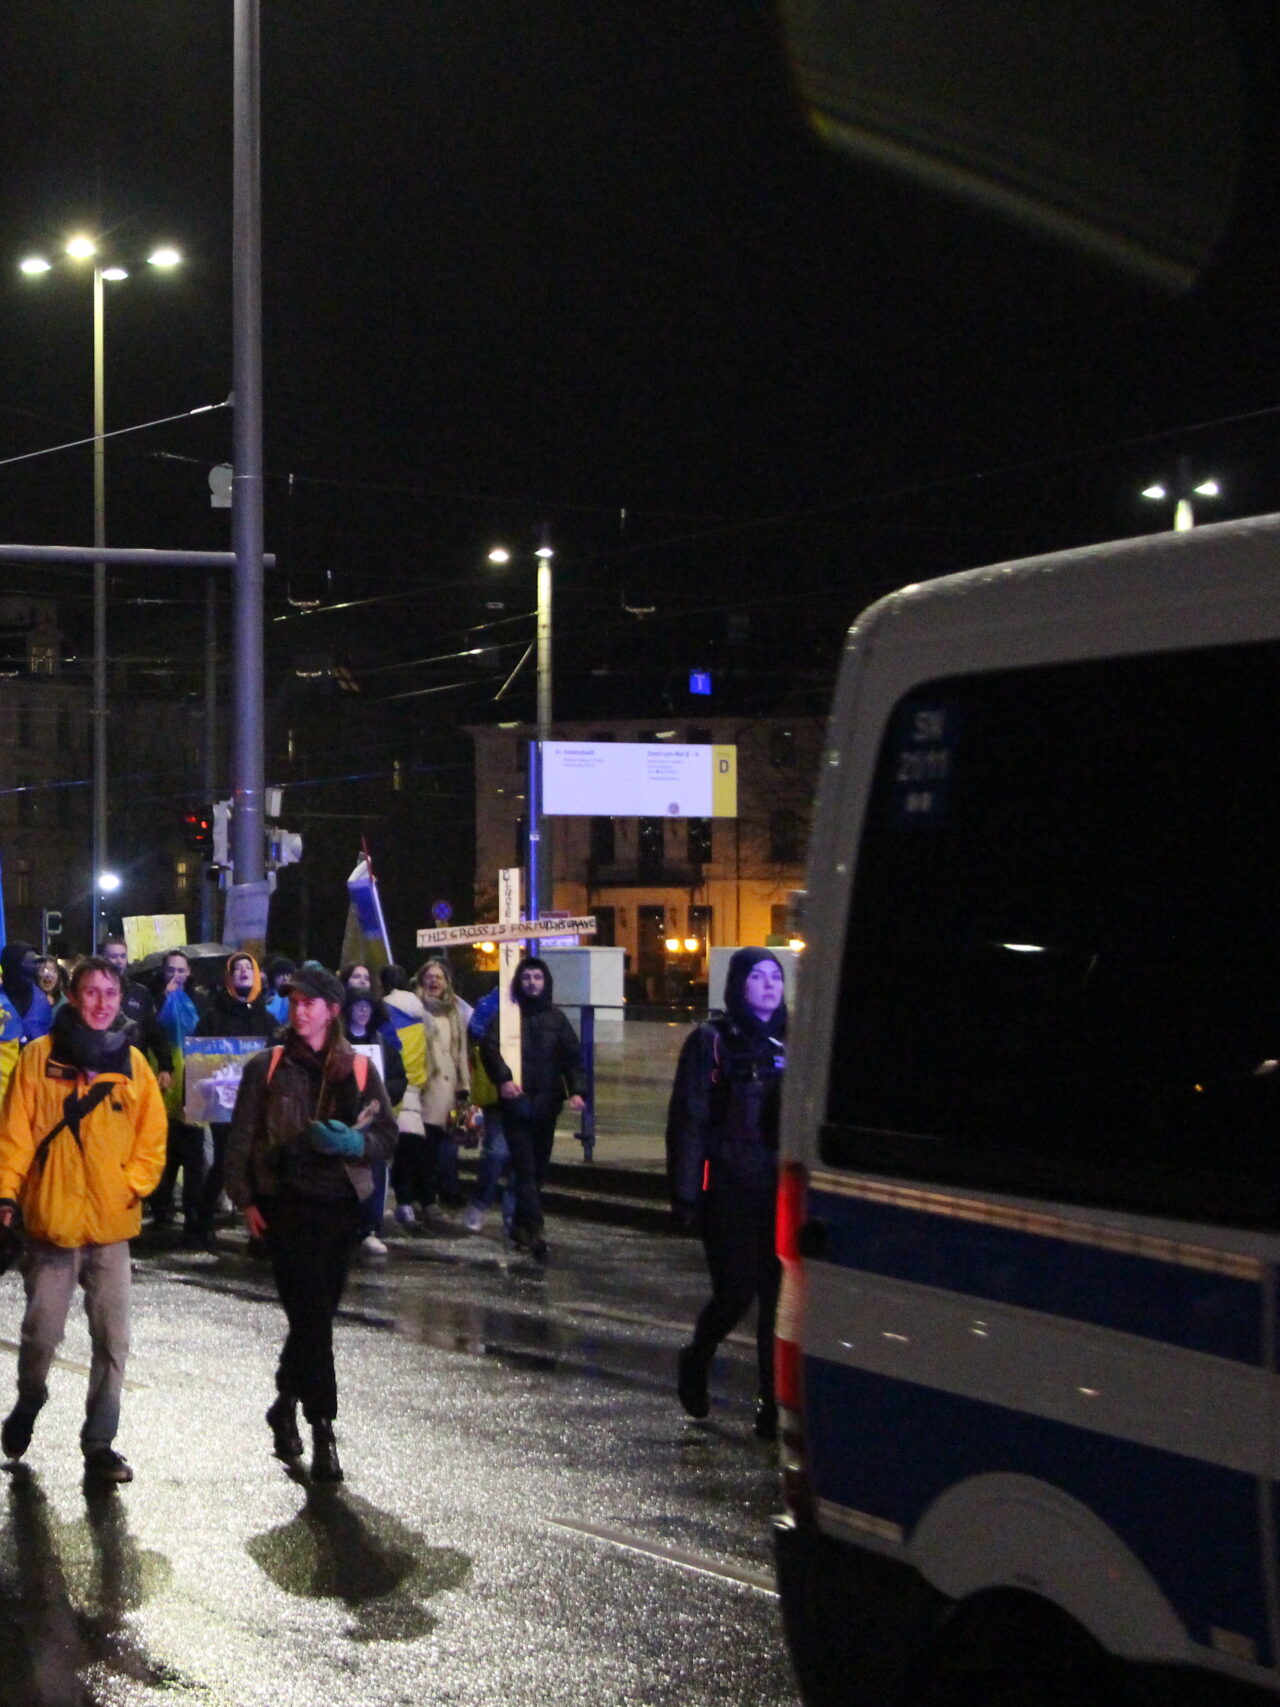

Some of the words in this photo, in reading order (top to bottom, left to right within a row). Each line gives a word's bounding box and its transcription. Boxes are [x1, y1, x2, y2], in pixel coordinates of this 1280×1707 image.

[719, 759, 729, 773] D
[419, 930, 448, 944] THIS
[450, 926, 490, 941] CROSS
[492, 924, 507, 936] IS
[511, 922, 535, 934] FOR
